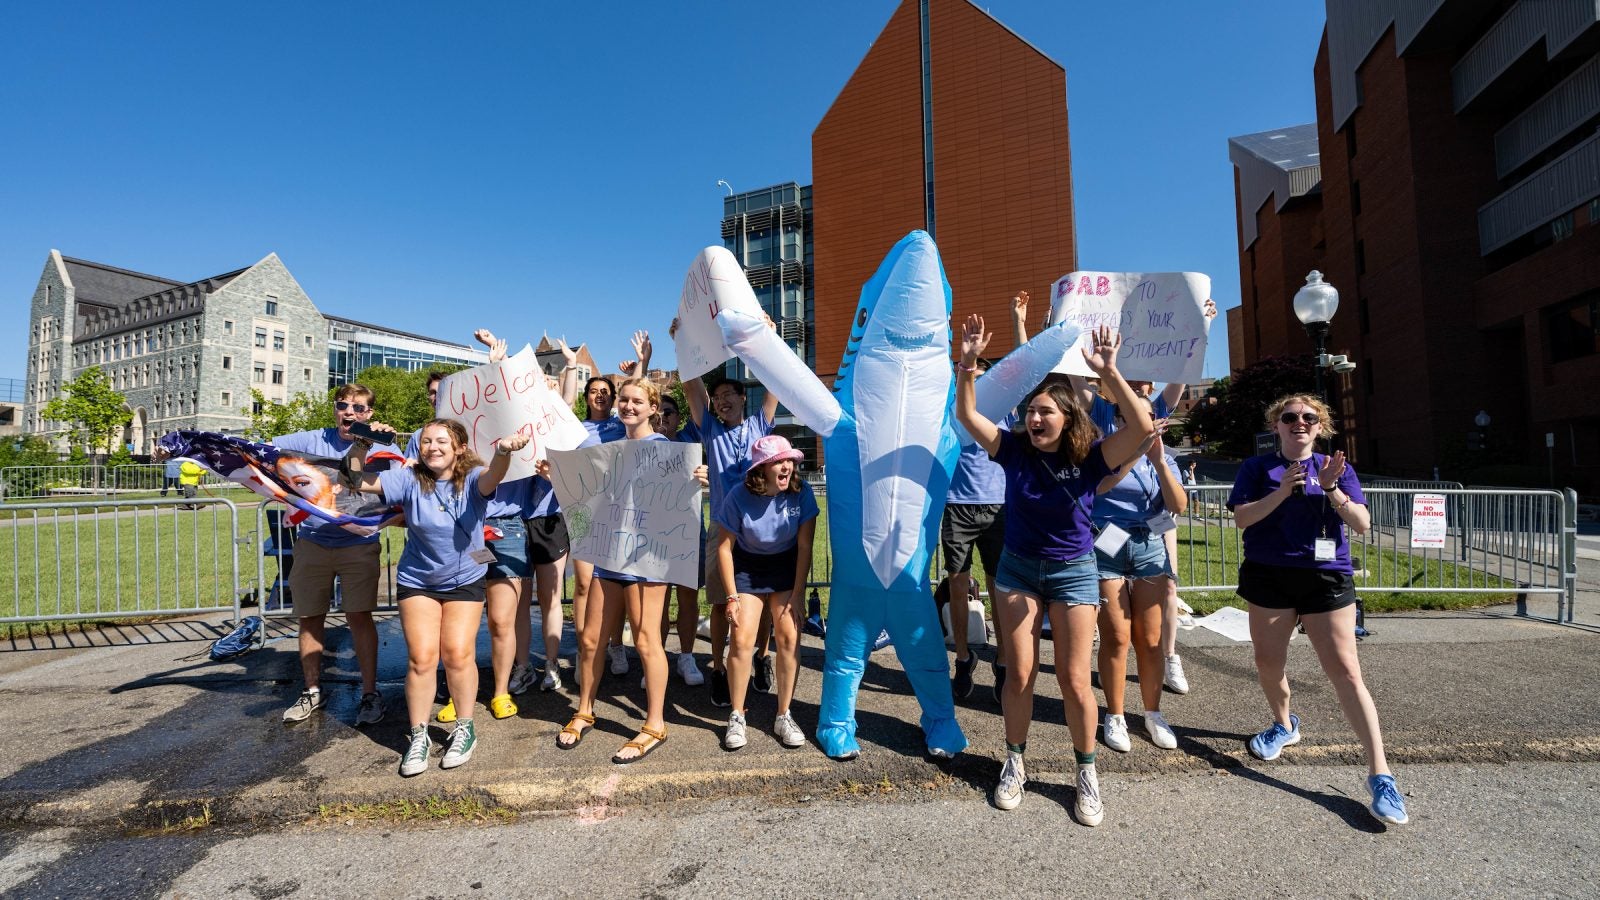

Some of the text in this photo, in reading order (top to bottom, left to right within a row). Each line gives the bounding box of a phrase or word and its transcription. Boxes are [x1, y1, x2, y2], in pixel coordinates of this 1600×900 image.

[1057, 276, 1156, 300] DAB TO
[1147, 310, 1175, 330] YOUR
[1120, 337, 1199, 359] STUDENT!
[635, 446, 658, 474] HOYA
[551, 450, 692, 512] Welcome
[609, 503, 650, 530] TO THE
